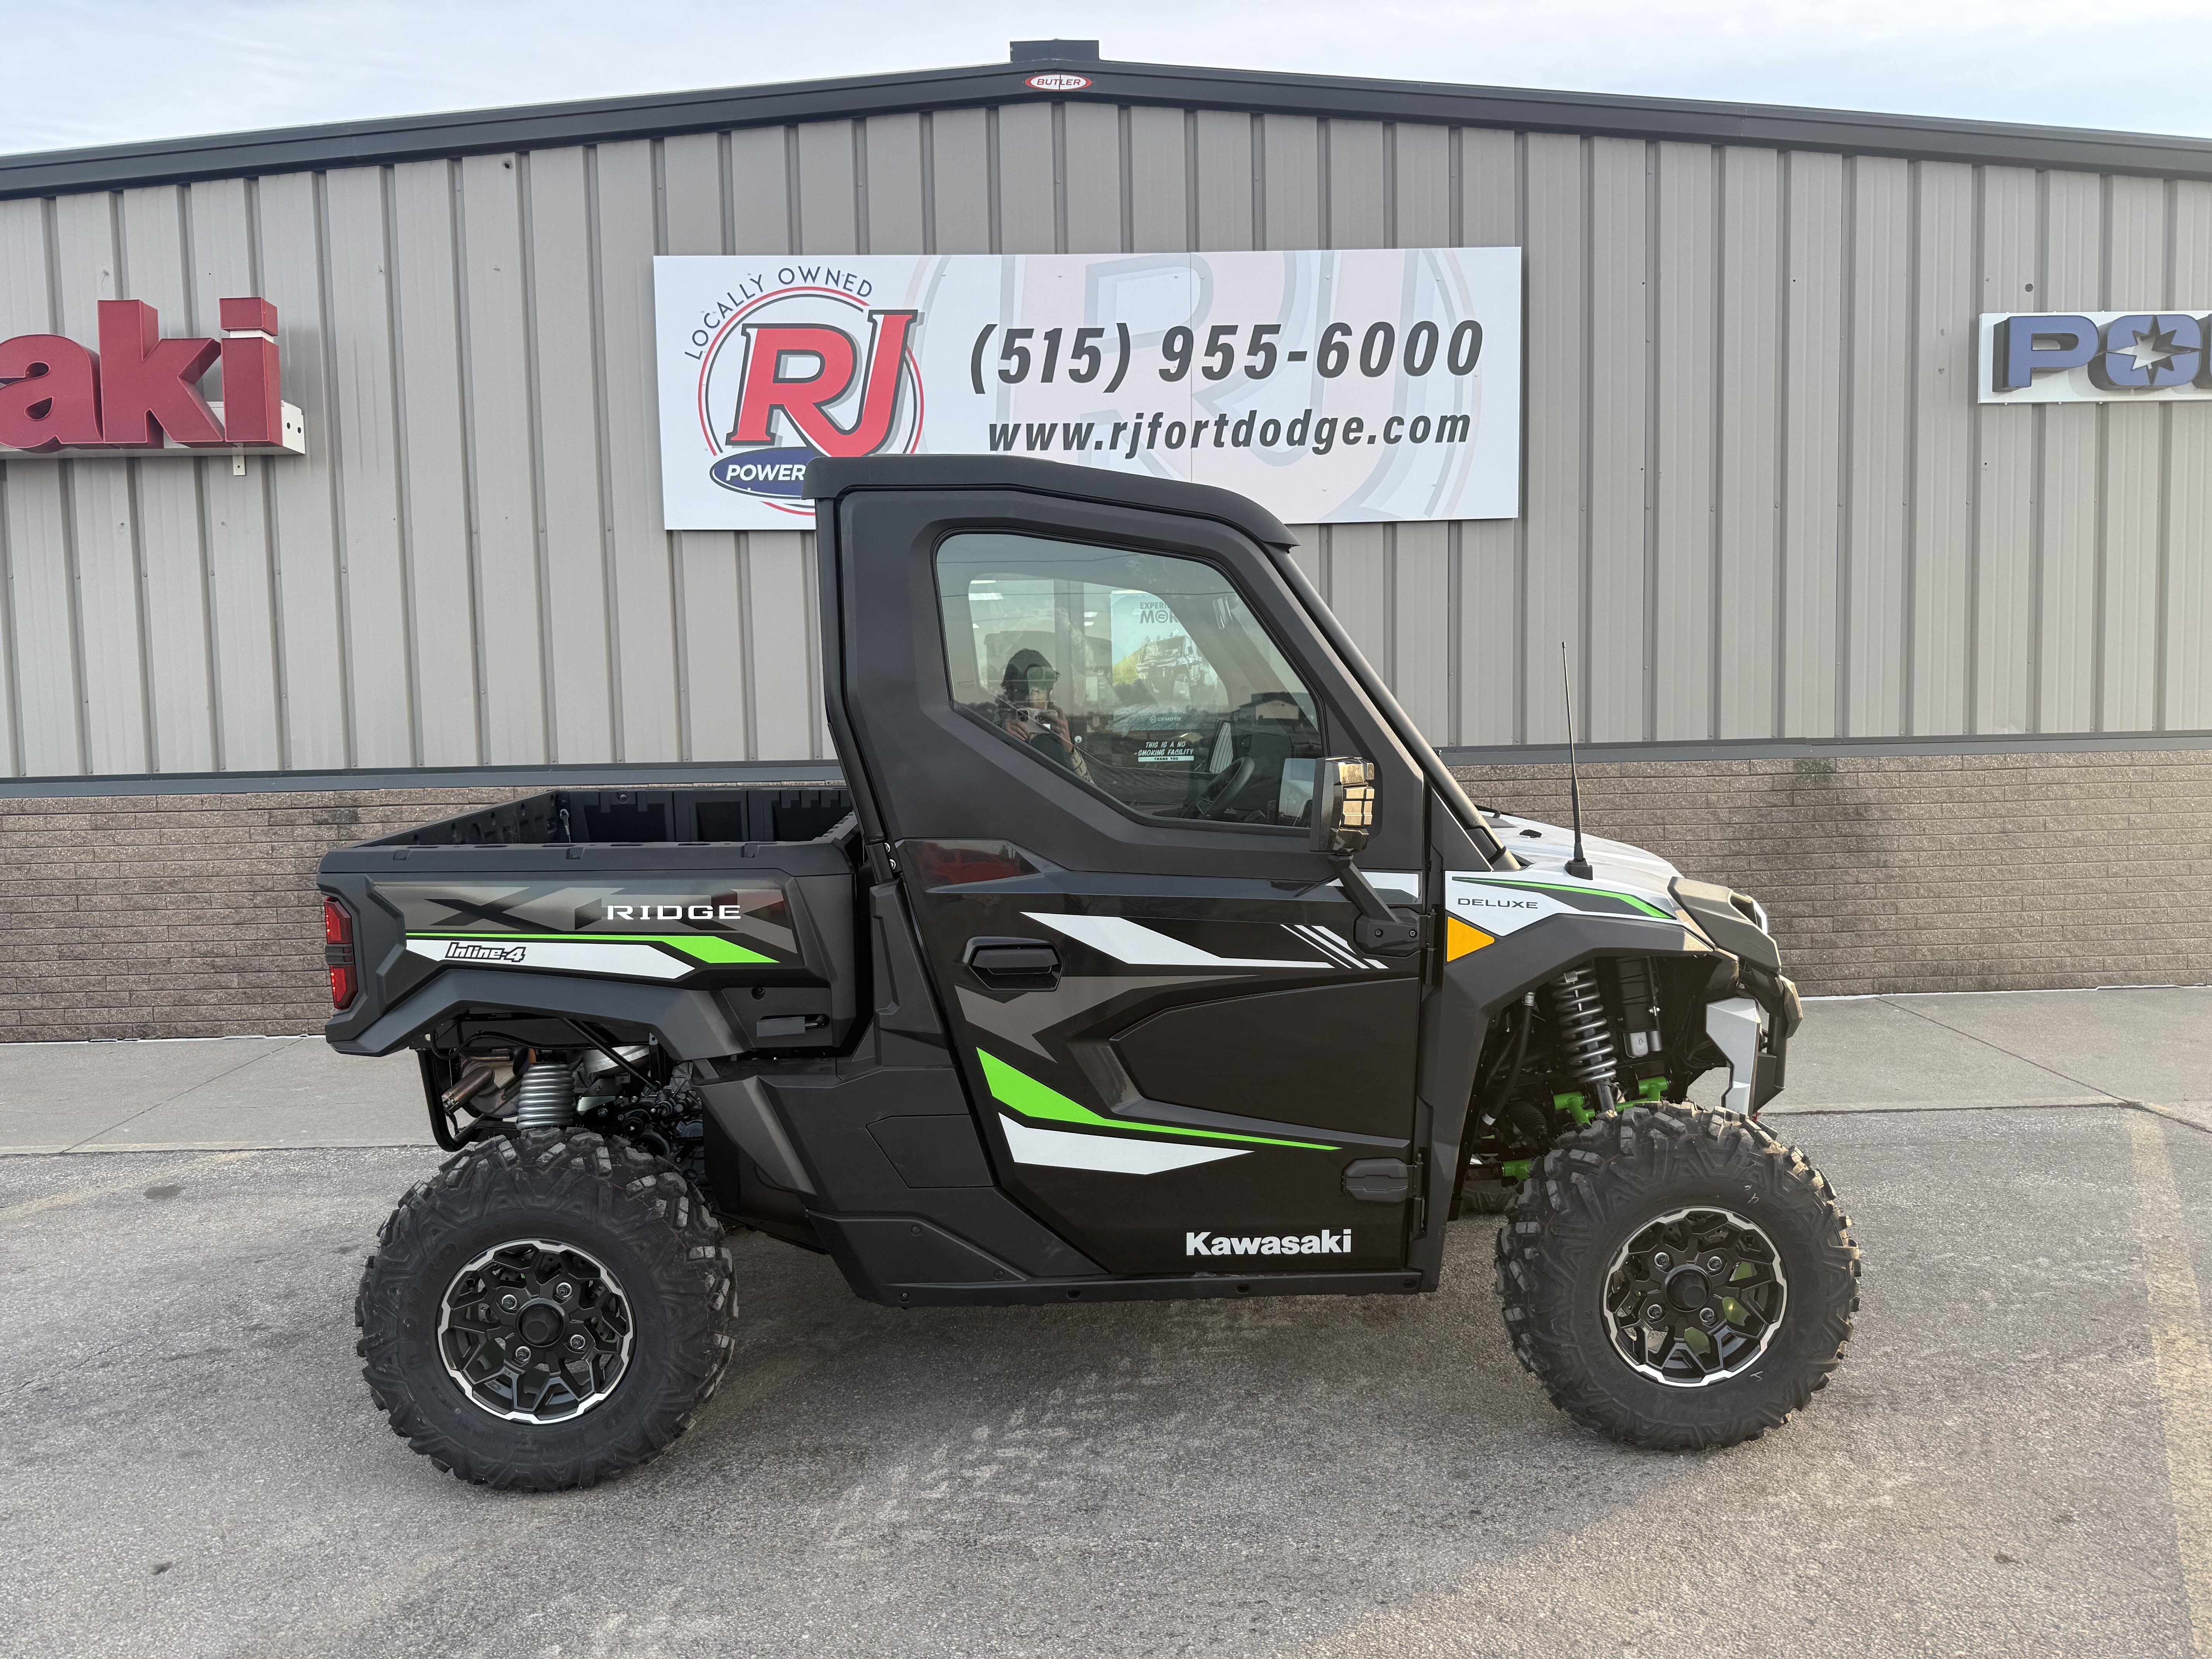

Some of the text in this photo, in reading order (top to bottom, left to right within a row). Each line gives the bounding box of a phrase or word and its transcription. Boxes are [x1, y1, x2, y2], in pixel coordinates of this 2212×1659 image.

[684, 266, 872, 360] LOCALLY OWNED
[971, 320, 1483, 394] (515) 955-6000
[1993, 314, 2212, 391] PO
[725, 309, 919, 457] RJ
[989, 409, 1470, 459] www.rjfortdodge.com
[607, 905, 741, 920] RIDGE
[1458, 898, 1538, 908] DELUXE
[445, 942, 526, 962] Inline-4
[1186, 1229, 1352, 1255] Kawasaki
